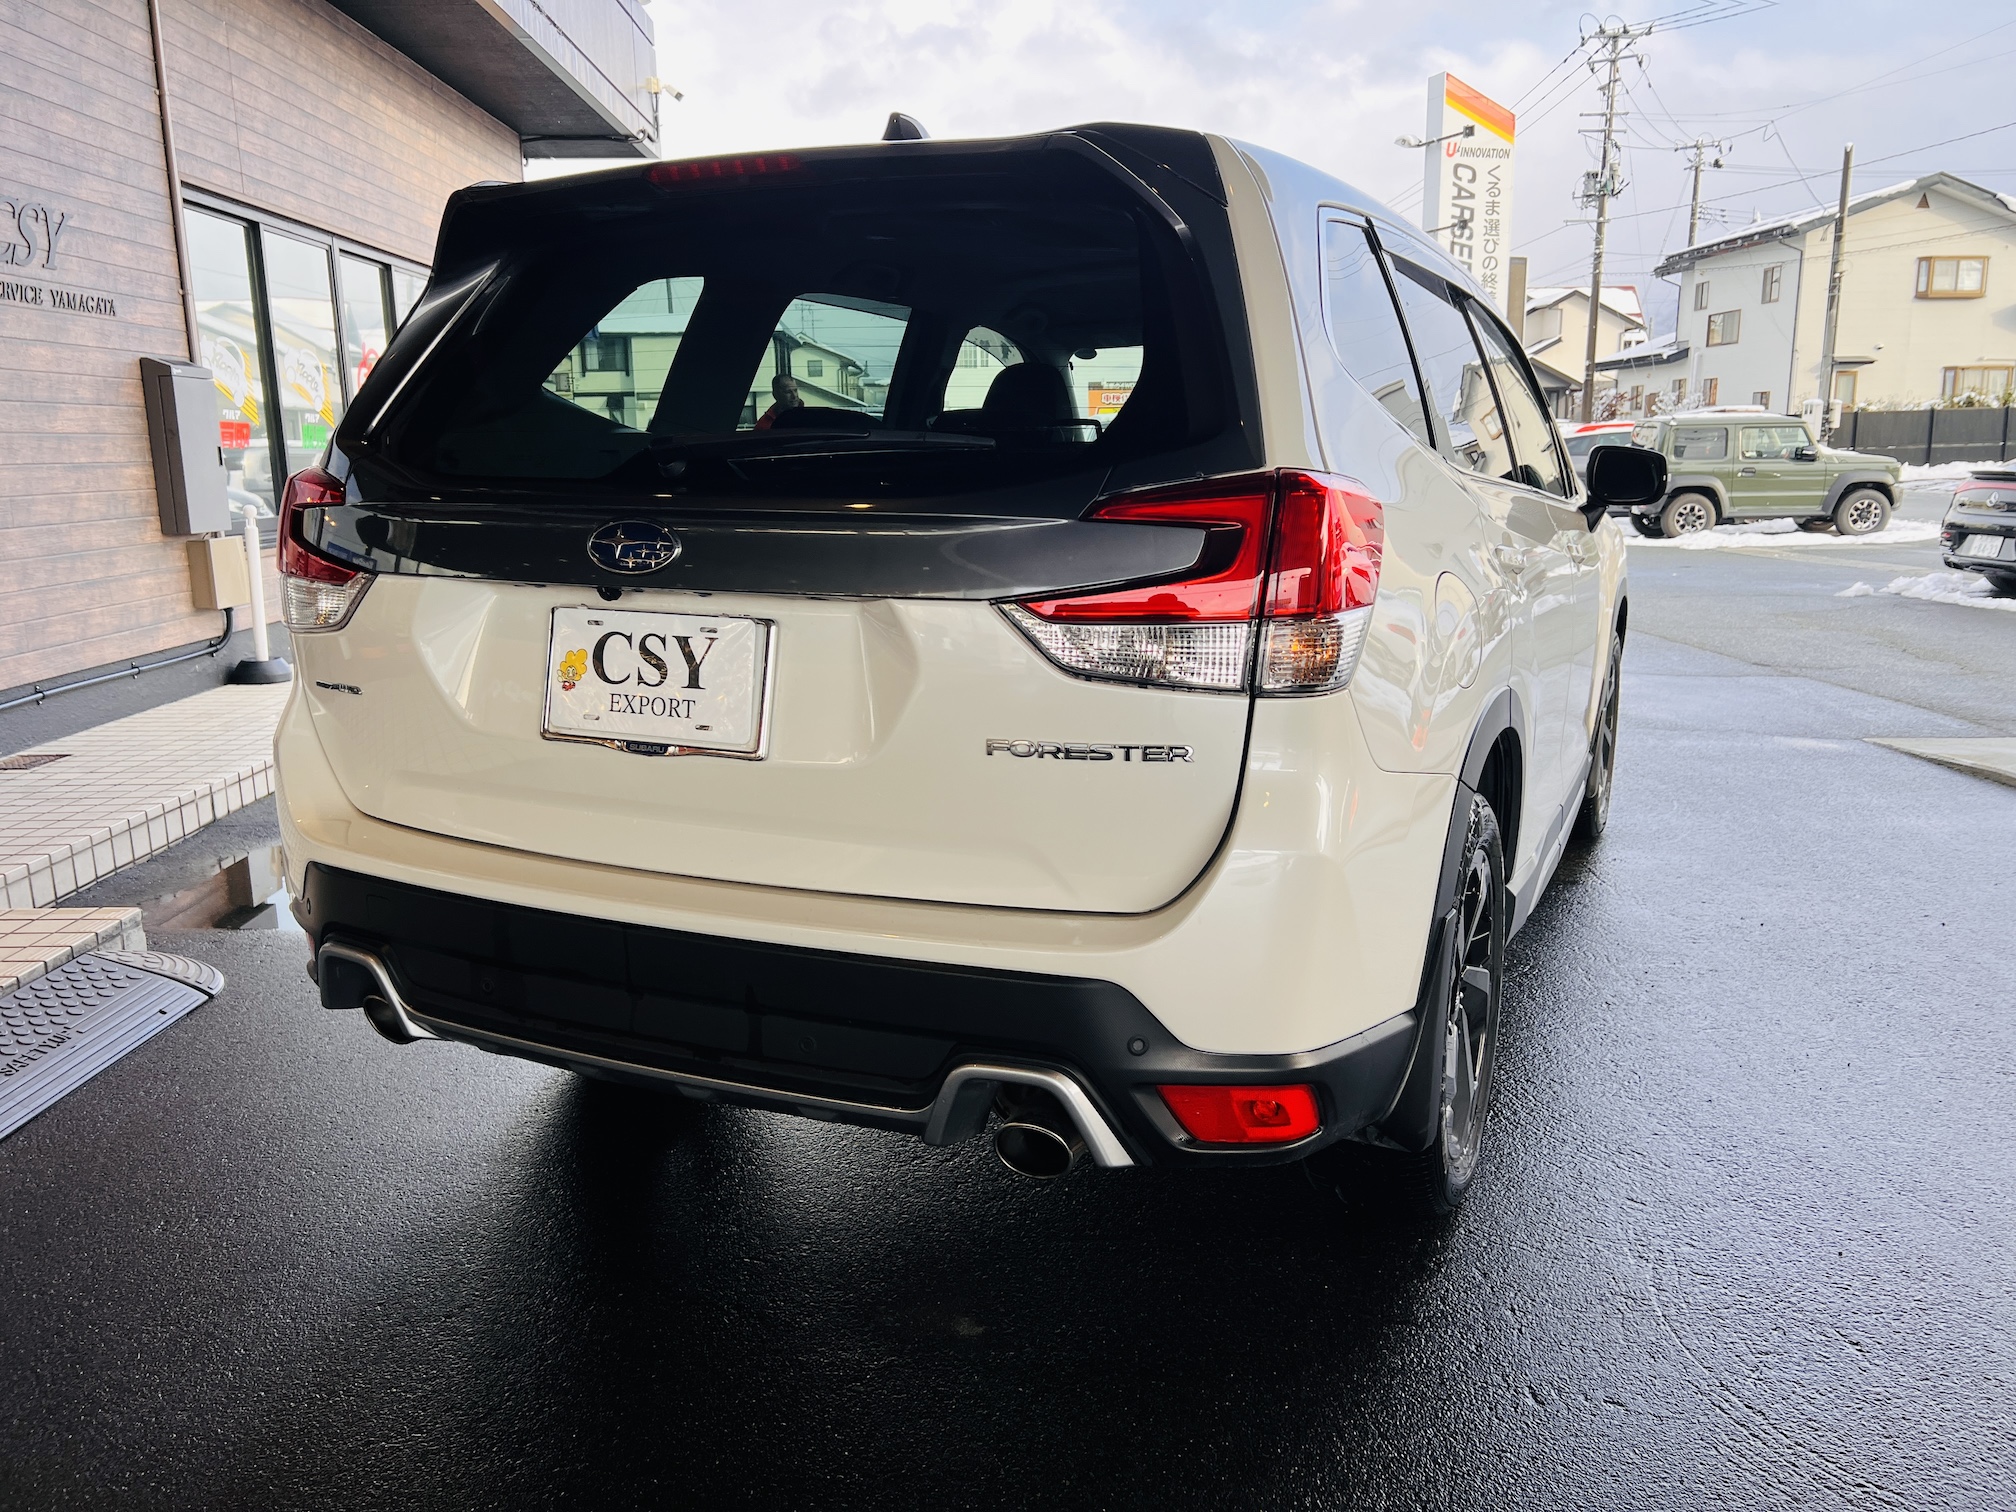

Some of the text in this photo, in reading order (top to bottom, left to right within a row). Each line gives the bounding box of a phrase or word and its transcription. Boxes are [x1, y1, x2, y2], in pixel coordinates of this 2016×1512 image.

[49, 288, 116, 316] YAMAGATA
[592, 631, 719, 690] CSY
[609, 693, 696, 719] EXPORT
[629, 743, 665, 753] SUBARU
[986, 738, 1195, 763] FORESTER
